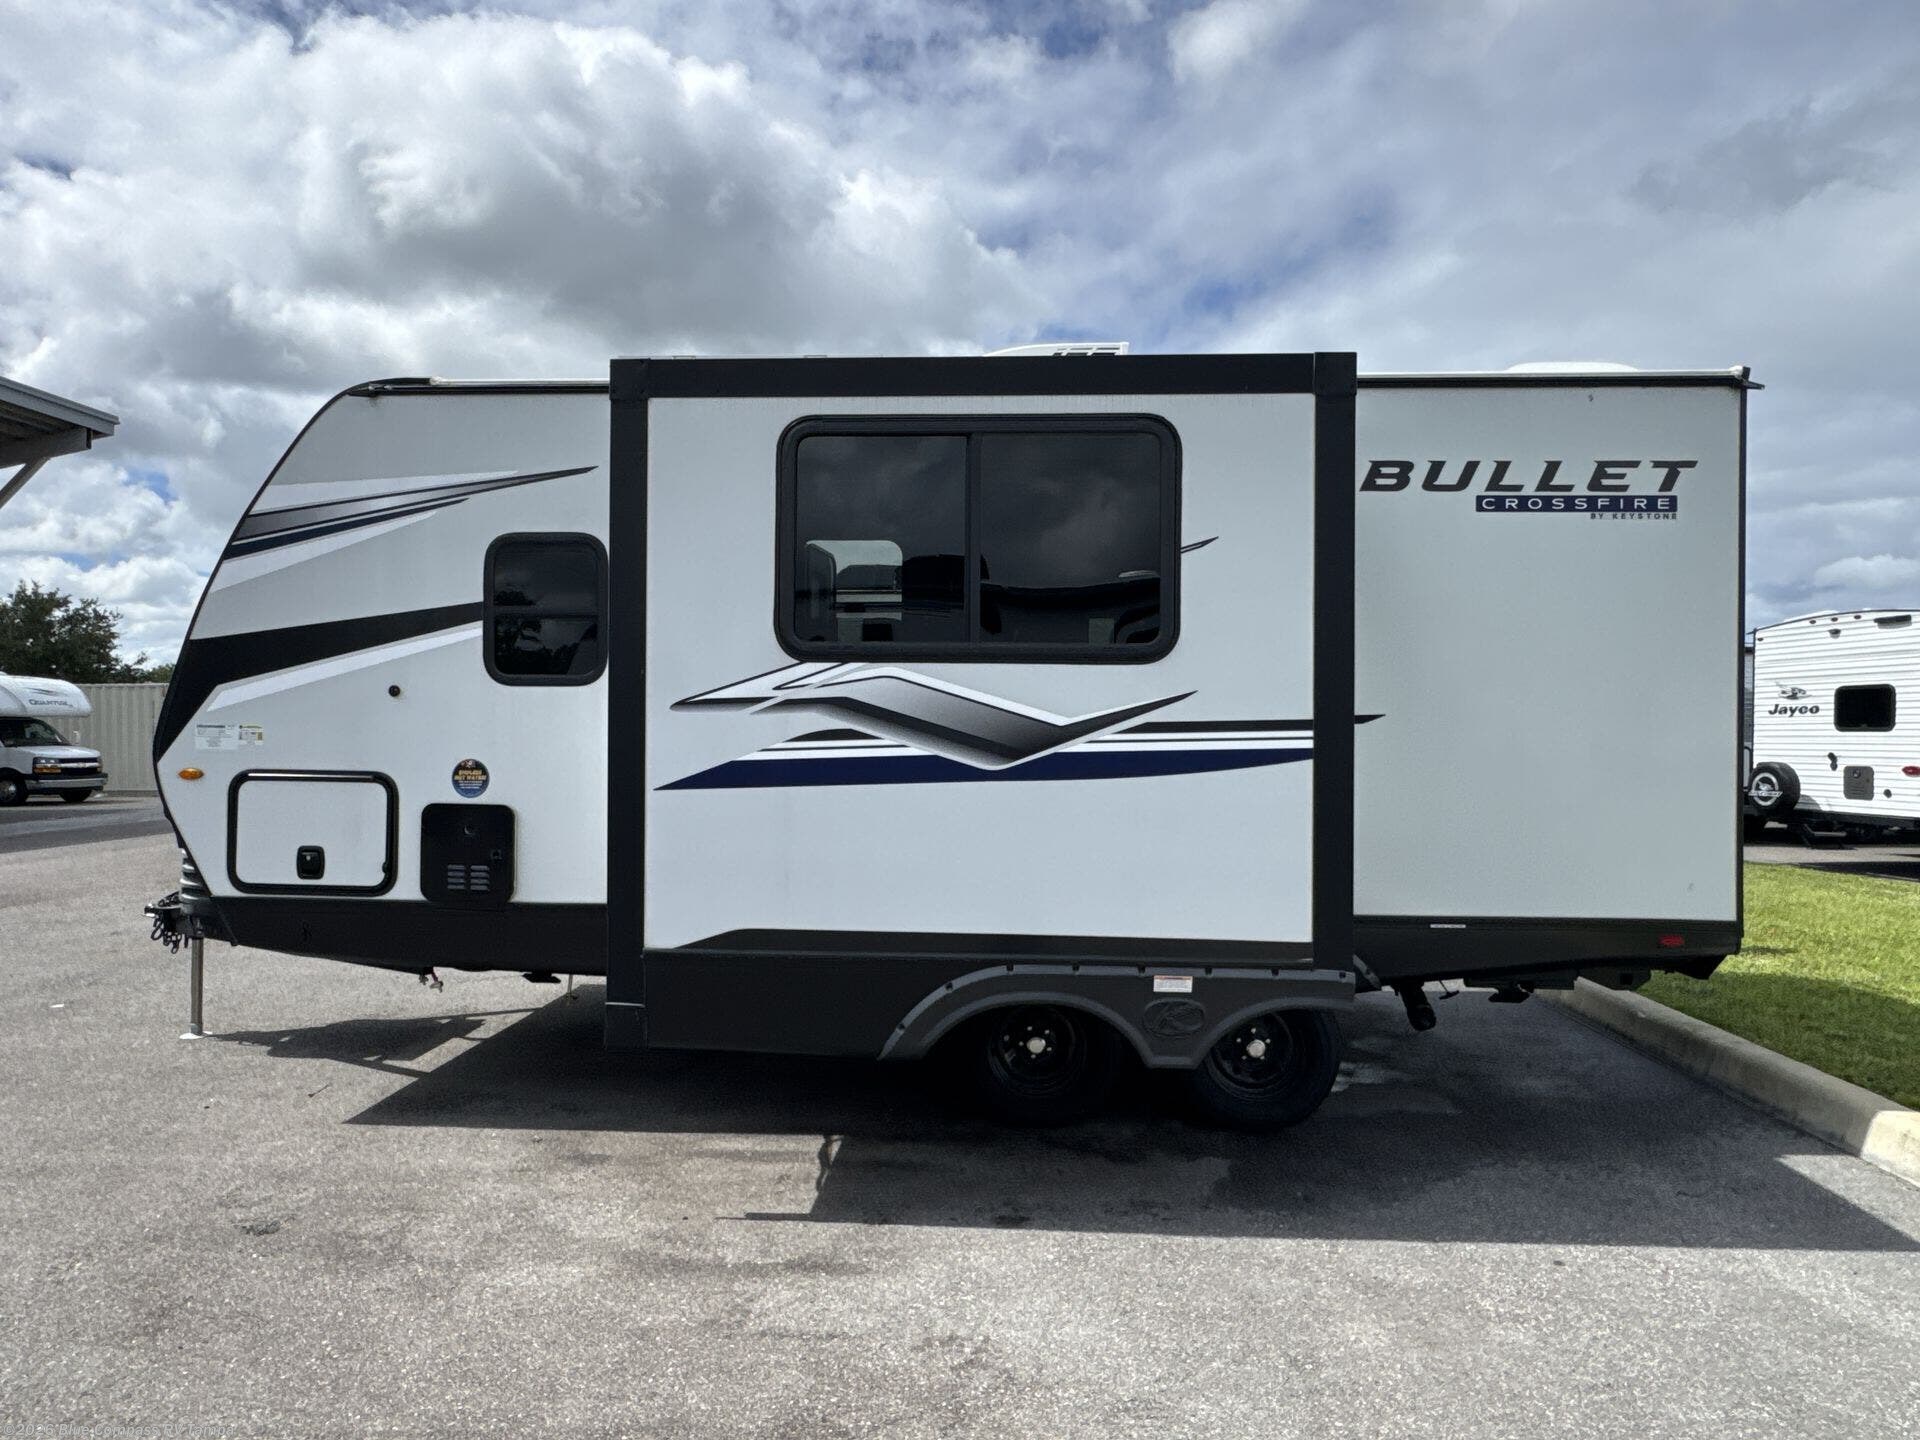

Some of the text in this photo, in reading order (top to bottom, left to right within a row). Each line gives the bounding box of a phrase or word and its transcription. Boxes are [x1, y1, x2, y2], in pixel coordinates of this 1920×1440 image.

[1359, 460, 1699, 493] BULLET
[1481, 498, 1671, 510] CROSSFIRE
[1767, 703, 1820, 718] Jayco
